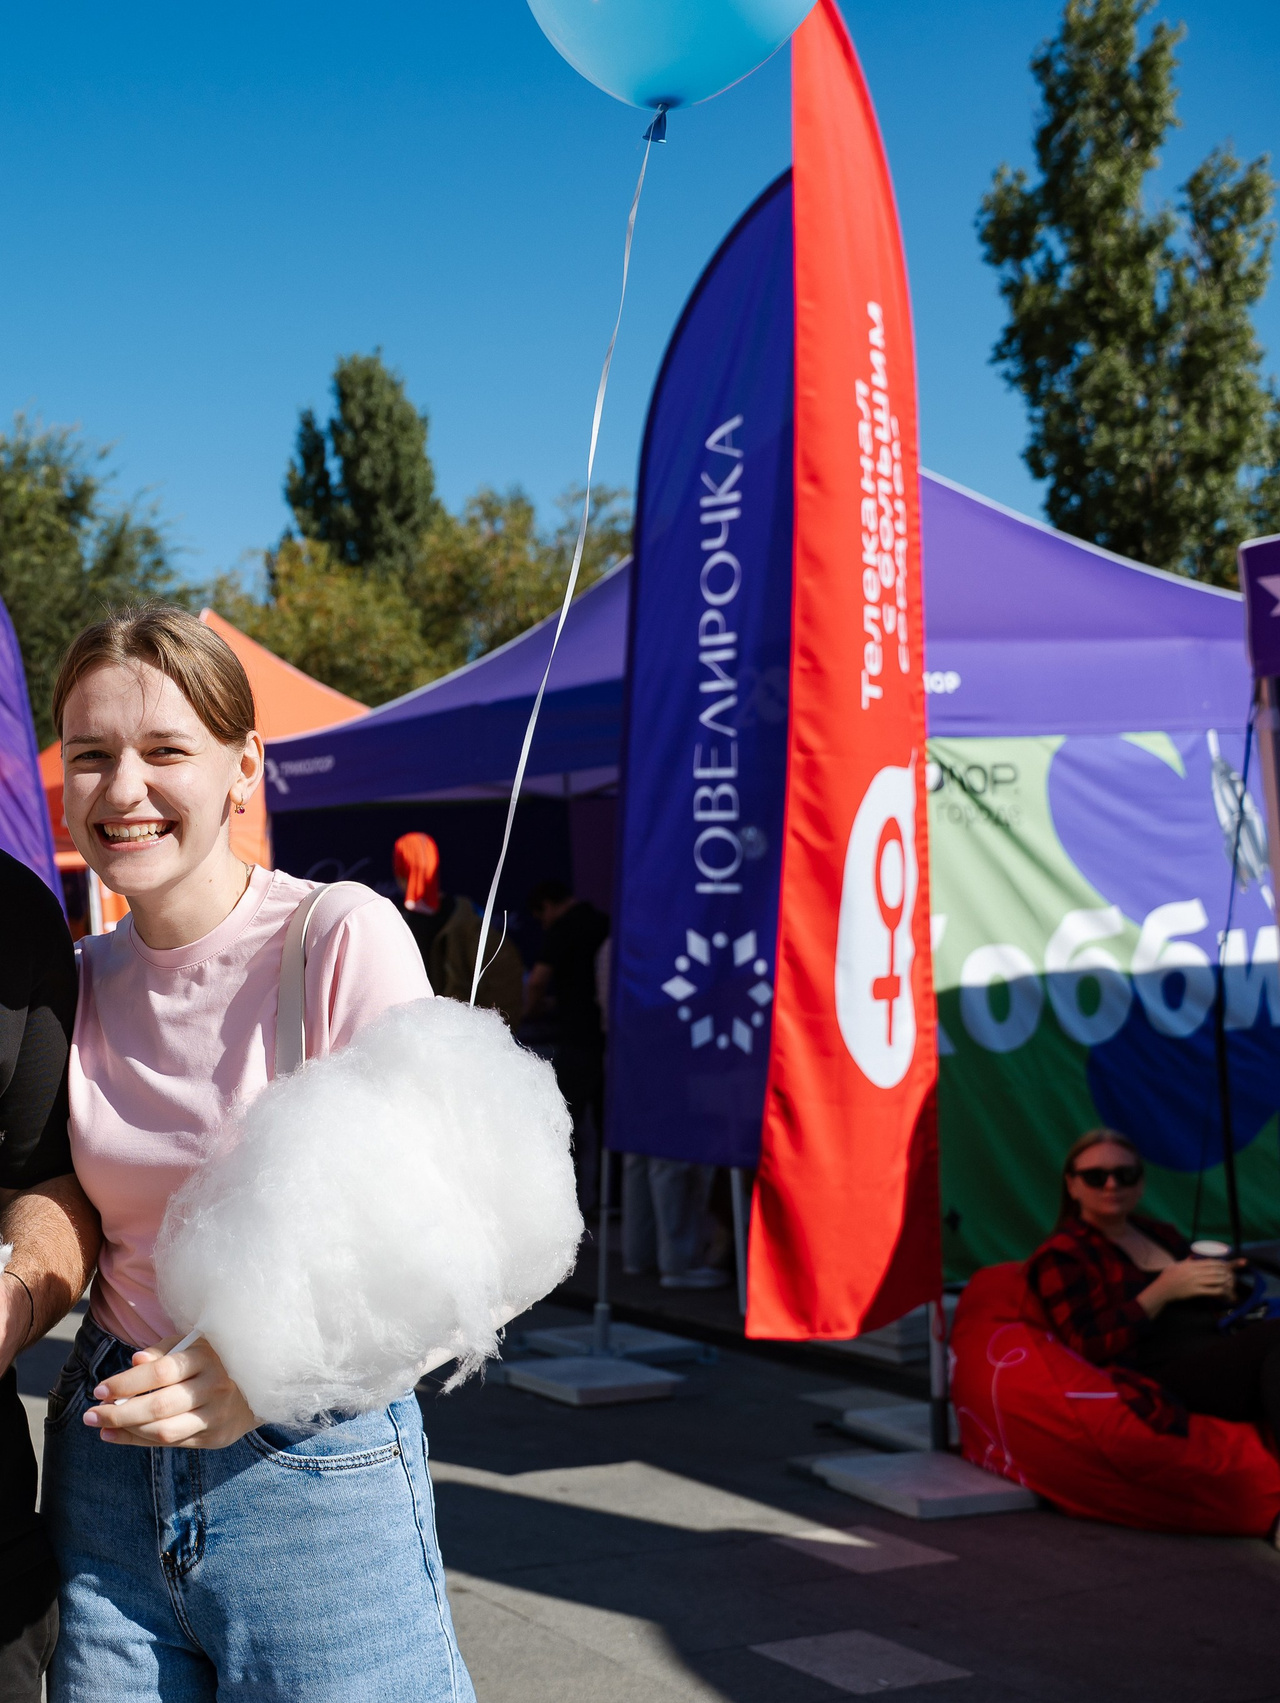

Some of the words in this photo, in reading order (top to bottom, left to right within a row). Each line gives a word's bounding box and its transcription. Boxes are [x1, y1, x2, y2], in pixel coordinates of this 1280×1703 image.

[856, 378, 884, 710] Телеканал
[867, 300, 896, 589] большим
[693, 413, 744, 895] ЮВЕЛИРОЧКА
[882, 602, 897, 635] с
